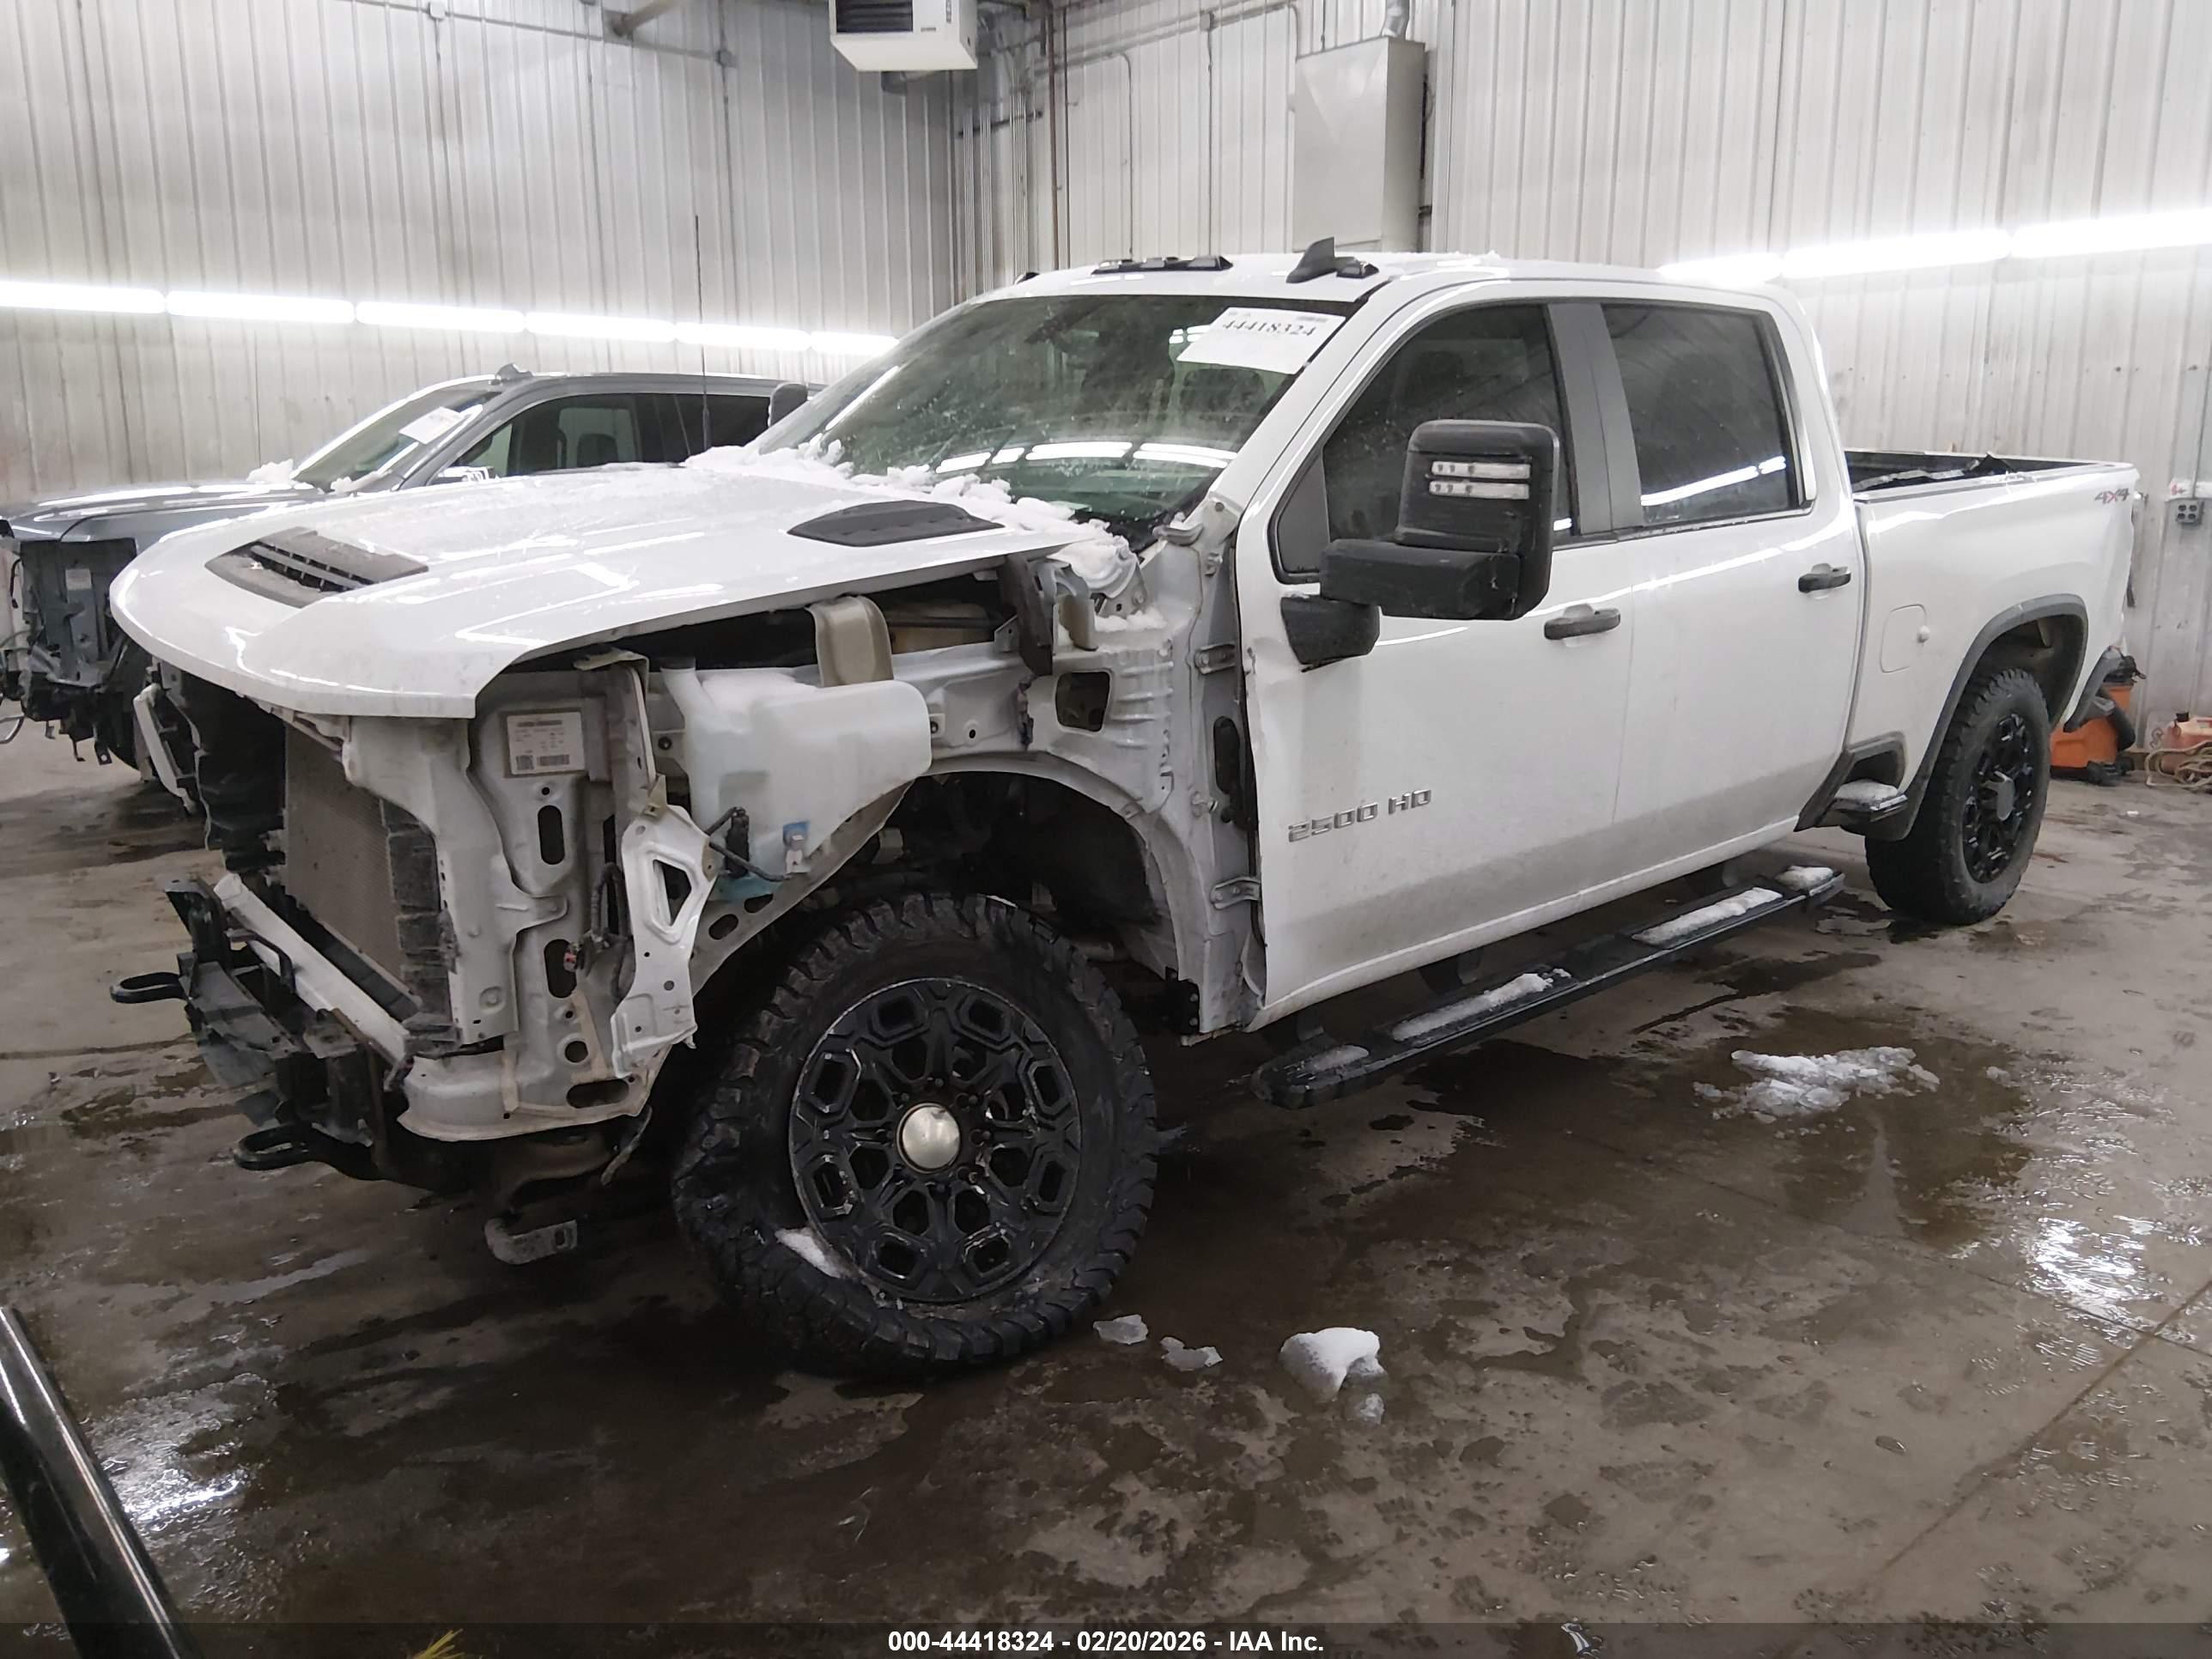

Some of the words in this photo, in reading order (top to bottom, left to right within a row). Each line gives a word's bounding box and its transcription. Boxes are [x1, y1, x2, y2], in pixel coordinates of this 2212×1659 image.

[1222, 319, 1316, 337] 44418324
[1288, 803, 1377, 842] 2500
[1388, 789, 1431, 815] HD
